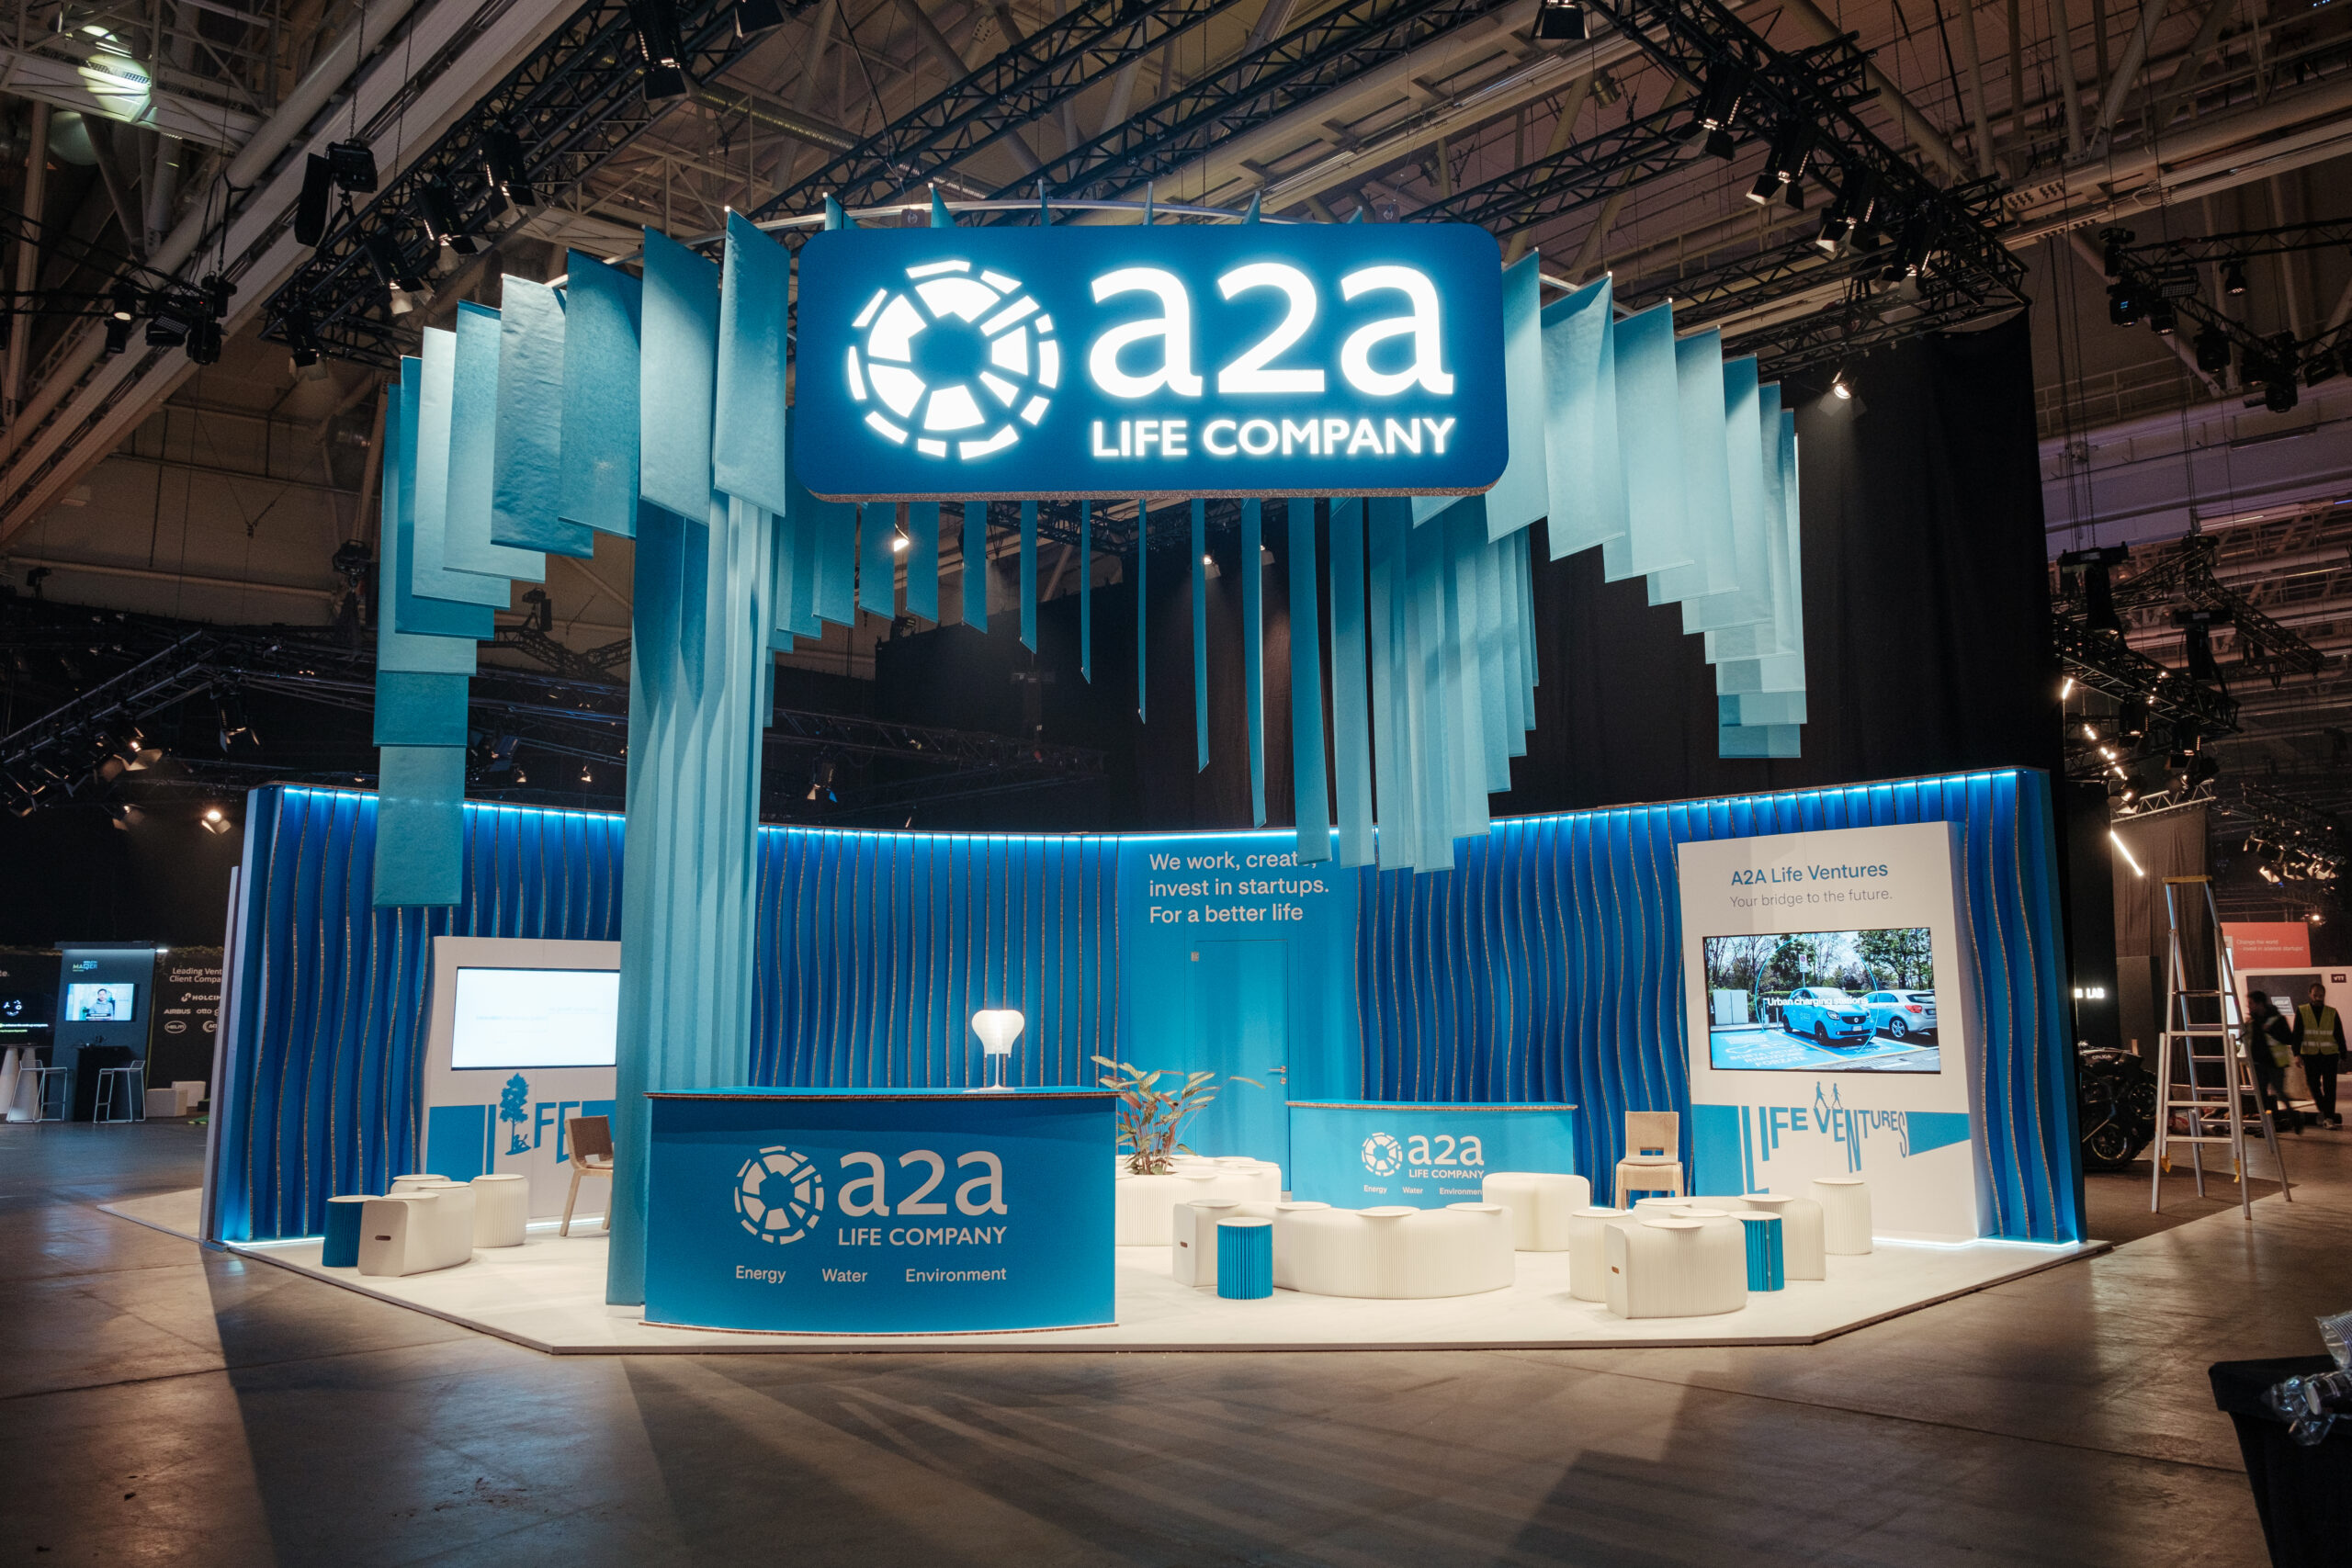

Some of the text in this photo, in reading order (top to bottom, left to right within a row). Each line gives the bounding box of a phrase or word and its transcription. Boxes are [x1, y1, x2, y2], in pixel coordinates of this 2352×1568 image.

[1090, 262, 1455, 398] a2a
[1092, 417, 1456, 457] LIFE COMPANY
[1149, 851, 1317, 871] We work, creat,
[1731, 862, 1888, 886] A2A Life Ventures
[1149, 878, 1329, 897] invest in startups.
[1730, 887, 1893, 908] Your bridge to the future.
[1149, 903, 1303, 923] For a better life
[173, 967, 203, 976] Leading
[194, 976, 221, 984] Compa
[1768, 996, 1869, 1009] Urban charging stations
[1408, 1134, 1485, 1166] a2a
[1742, 1106, 1907, 1194] LIFE VENTURES
[838, 1149, 1008, 1217] a2a
[1408, 1169, 1484, 1179] LIFE COMPANY
[1363, 1184, 1482, 1195] Energy Water Environmen
[839, 1226, 1007, 1246] LIFE COMPANY
[736, 1266, 1007, 1284] Energy Water Environment
